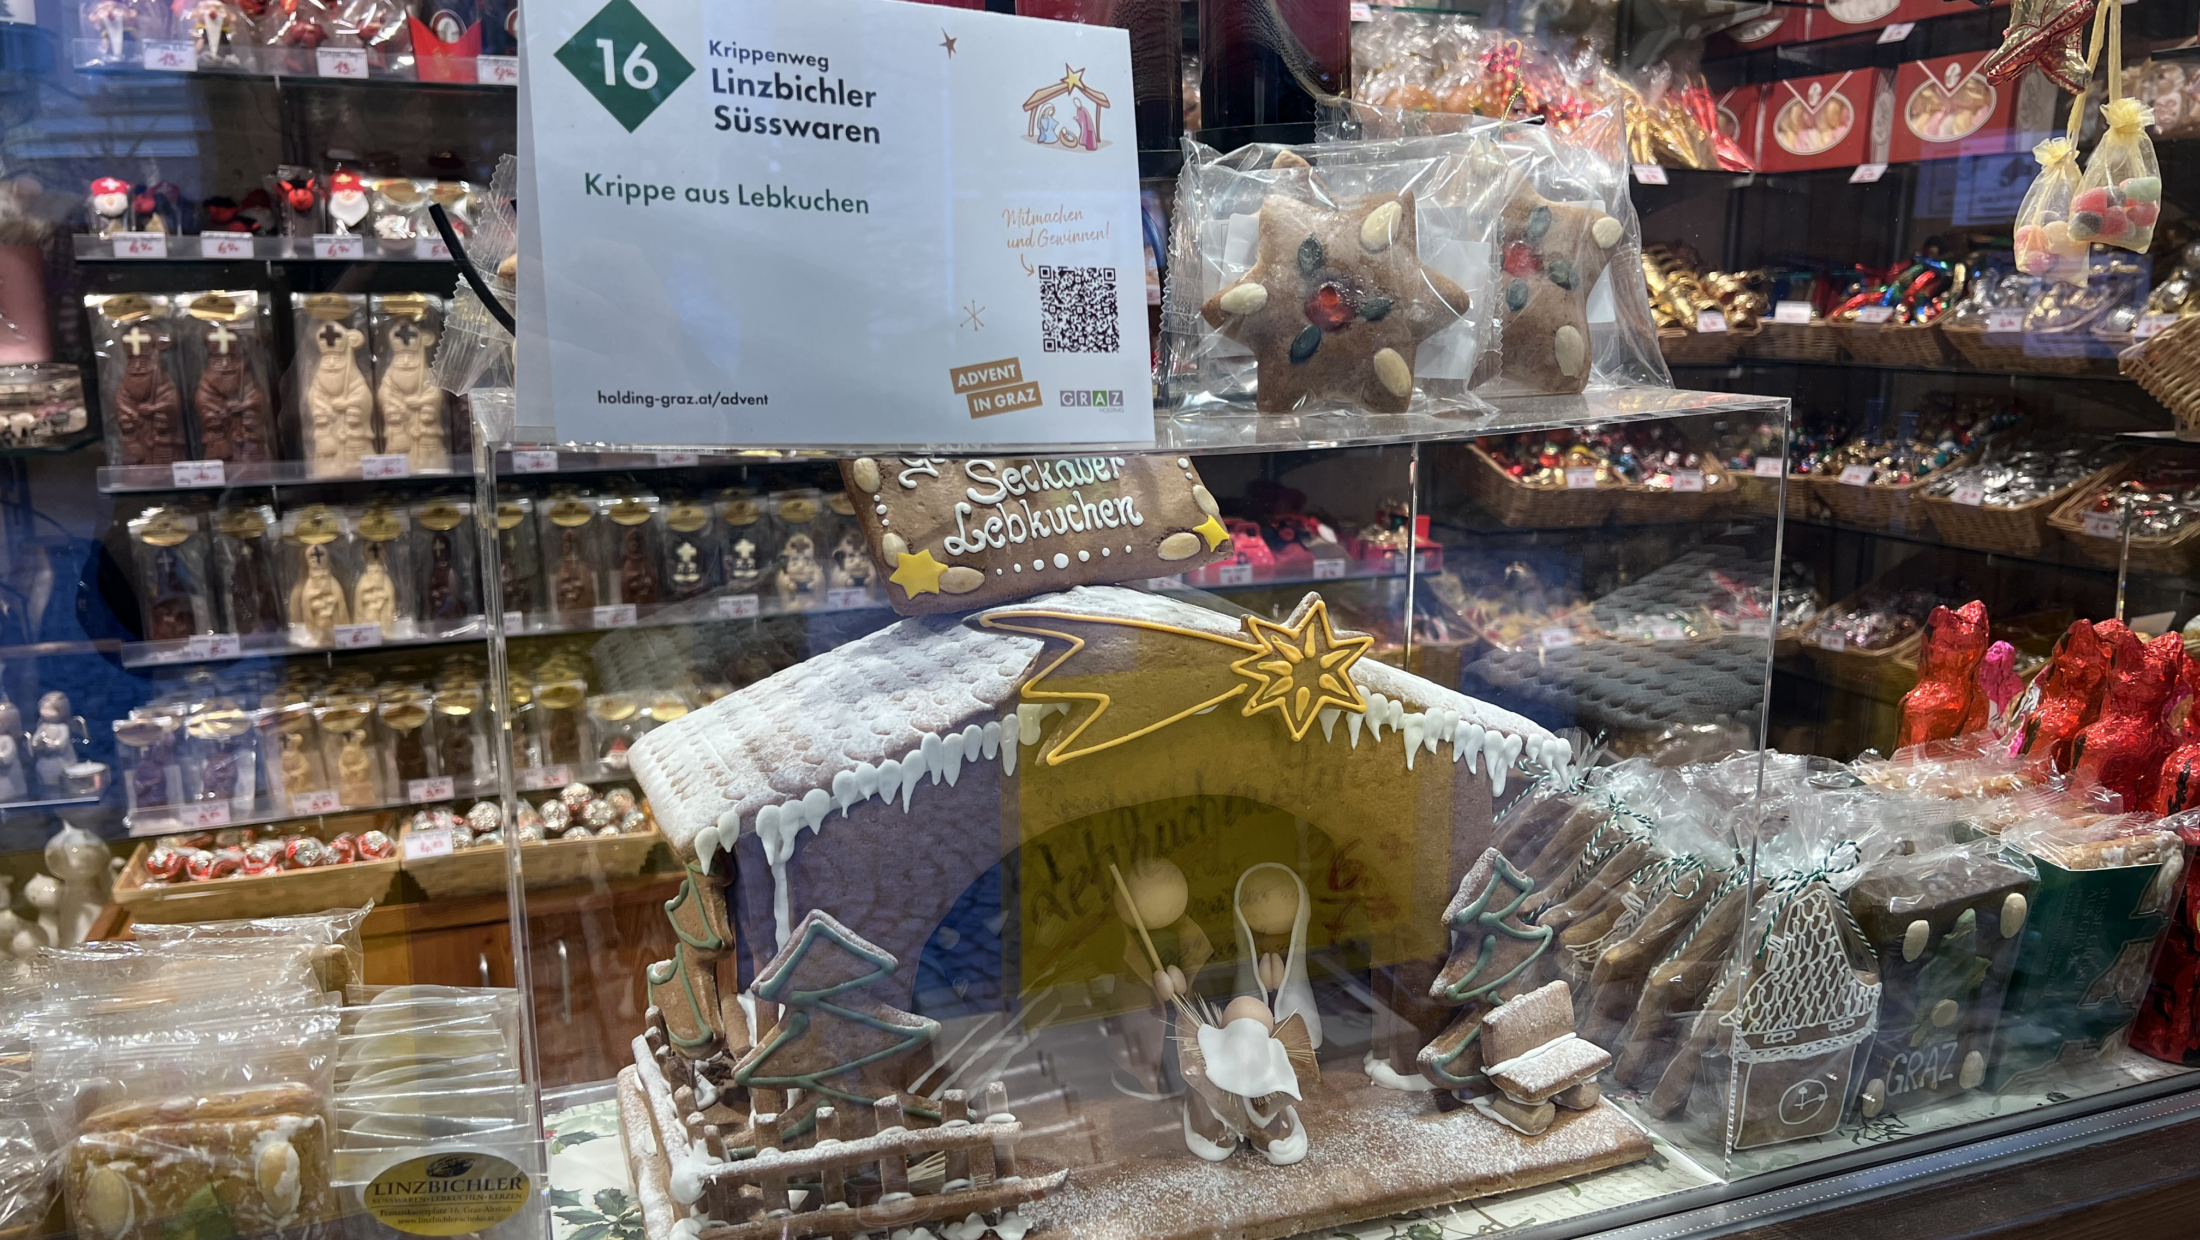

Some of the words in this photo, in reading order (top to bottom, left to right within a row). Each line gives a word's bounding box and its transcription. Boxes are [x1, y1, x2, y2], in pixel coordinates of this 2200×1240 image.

[596, 38, 659, 90] 16
[708, 40, 830, 72] Krippenweg
[712, 67, 877, 108] Linzbichler
[714, 104, 881, 144] Süsswaren
[585, 172, 677, 206] Krippe
[685, 185, 730, 205] aus
[738, 184, 870, 214] Lebkuchen
[1002, 204, 1084, 228] Mitmachen
[1007, 229, 1035, 249] und
[1037, 222, 1111, 248] Gewinnen!
[957, 364, 1016, 388] ADVENT
[598, 390, 769, 408] holding-graz.at/advent
[973, 398, 992, 413] IN
[995, 388, 1037, 409] GRAZ
[1061, 391, 1123, 406] GRAZ
[943, 490, 1144, 556] Lebkuchen
[2083, 888, 2099, 917] AUS
[1885, 1041, 1959, 1097] GRAZ
[374, 1176, 523, 1196] LINZBICHLER
[380, 1207, 447, 1217] Franziskanerplatz
[463, 1205, 514, 1214] Graz-Altstadt
